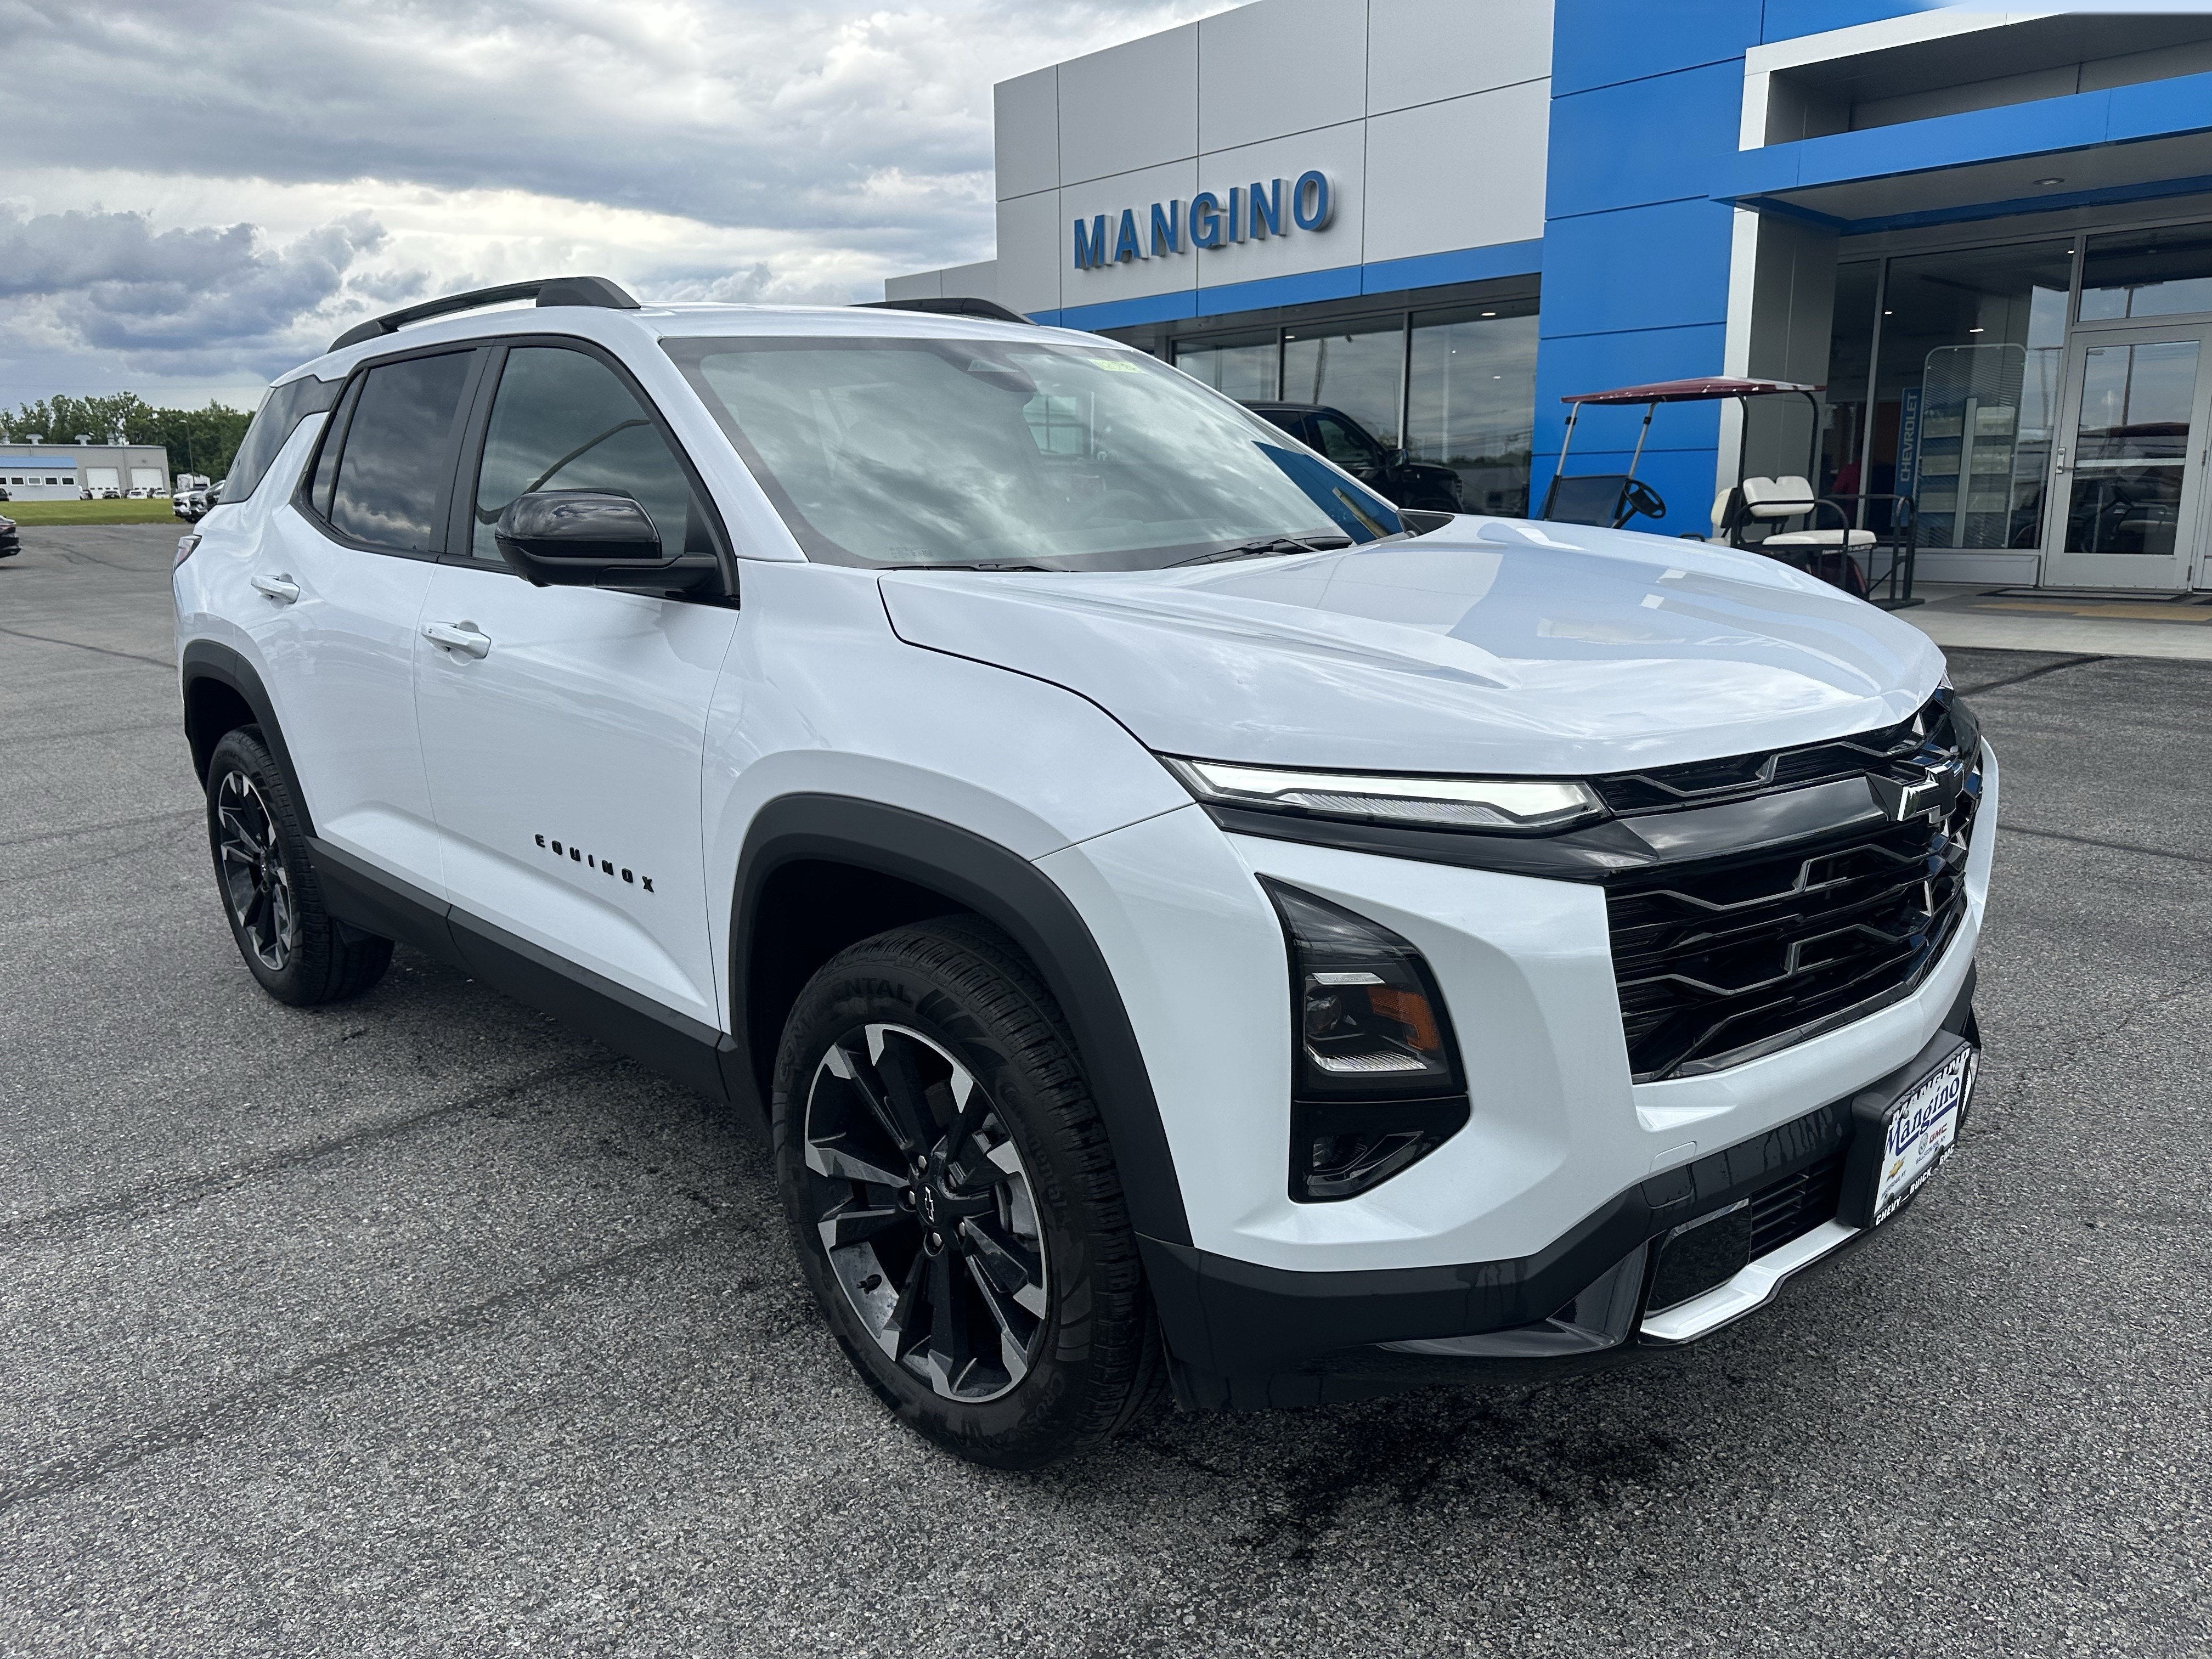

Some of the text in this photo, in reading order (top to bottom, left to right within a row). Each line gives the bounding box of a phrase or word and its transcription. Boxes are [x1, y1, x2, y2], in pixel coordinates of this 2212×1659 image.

[1074, 170, 1335, 270] MANGINO
[1900, 392, 1918, 482] CHEVROLET
[535, 833, 654, 893] EQUINOX
[1888, 1076, 1960, 1156] Mangino
[1892, 1047, 1971, 1121] MANGINO
[1929, 1122, 1948, 1144] GMC
[1875, 1143, 1955, 1226] CHEVY BUICK GMC
